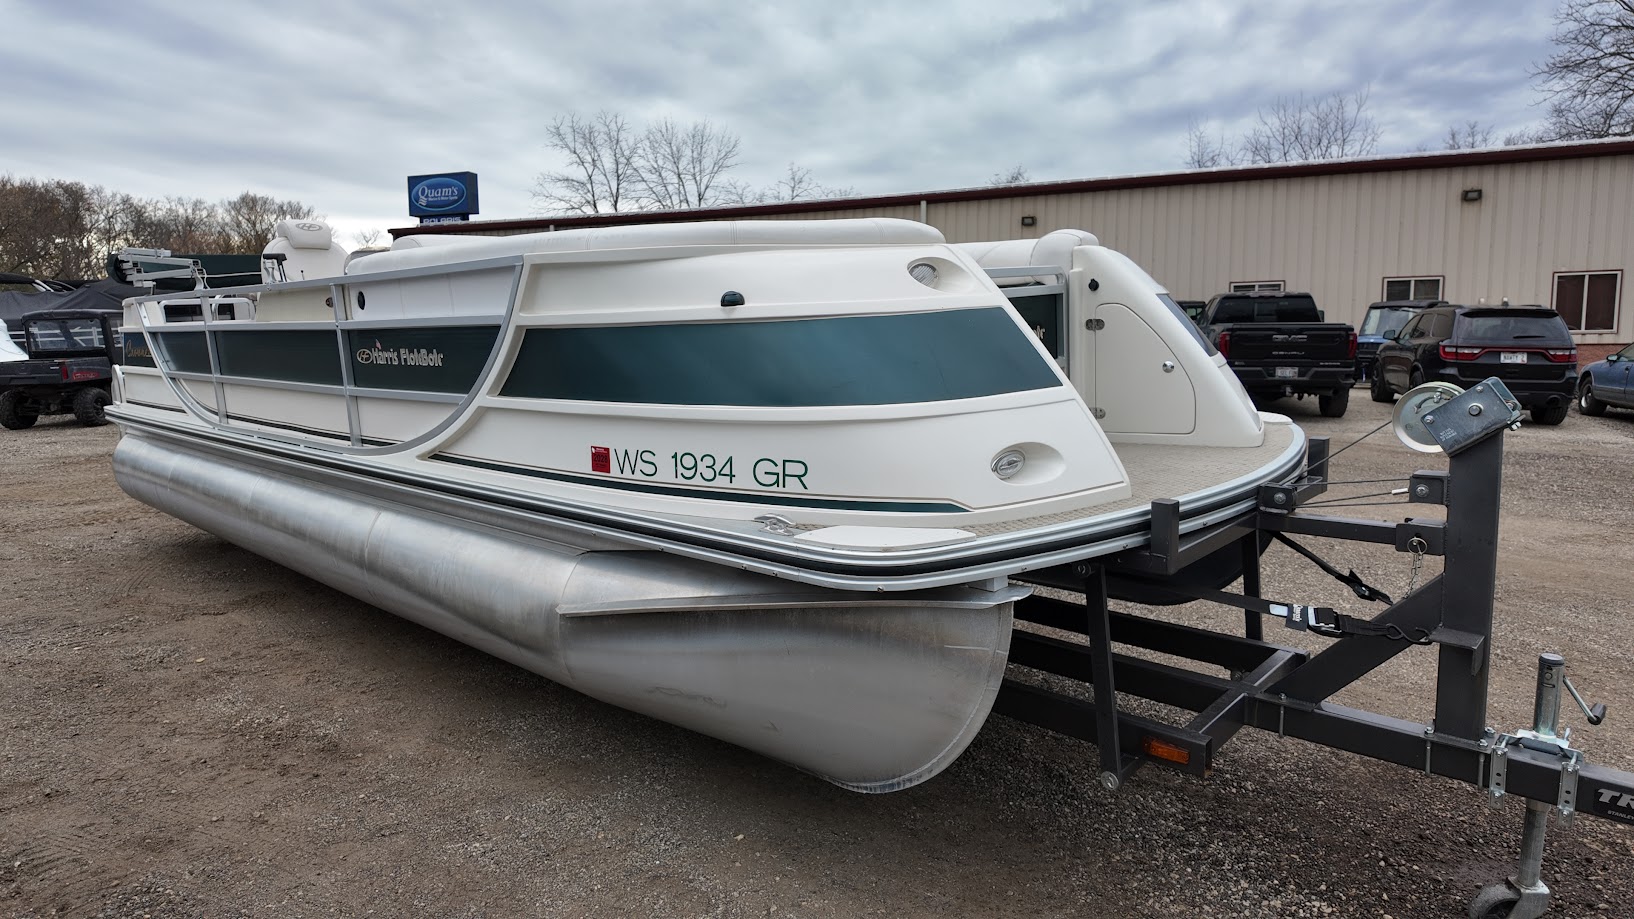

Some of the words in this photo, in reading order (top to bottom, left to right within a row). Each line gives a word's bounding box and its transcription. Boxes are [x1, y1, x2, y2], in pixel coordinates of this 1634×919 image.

[418, 185, 458, 202] Quam's
[422, 216, 461, 224] POLARIS
[371, 348, 398, 365] Harris
[614, 448, 658, 476] WS
[671, 451, 736, 484] 1934
[752, 457, 809, 490] GR
